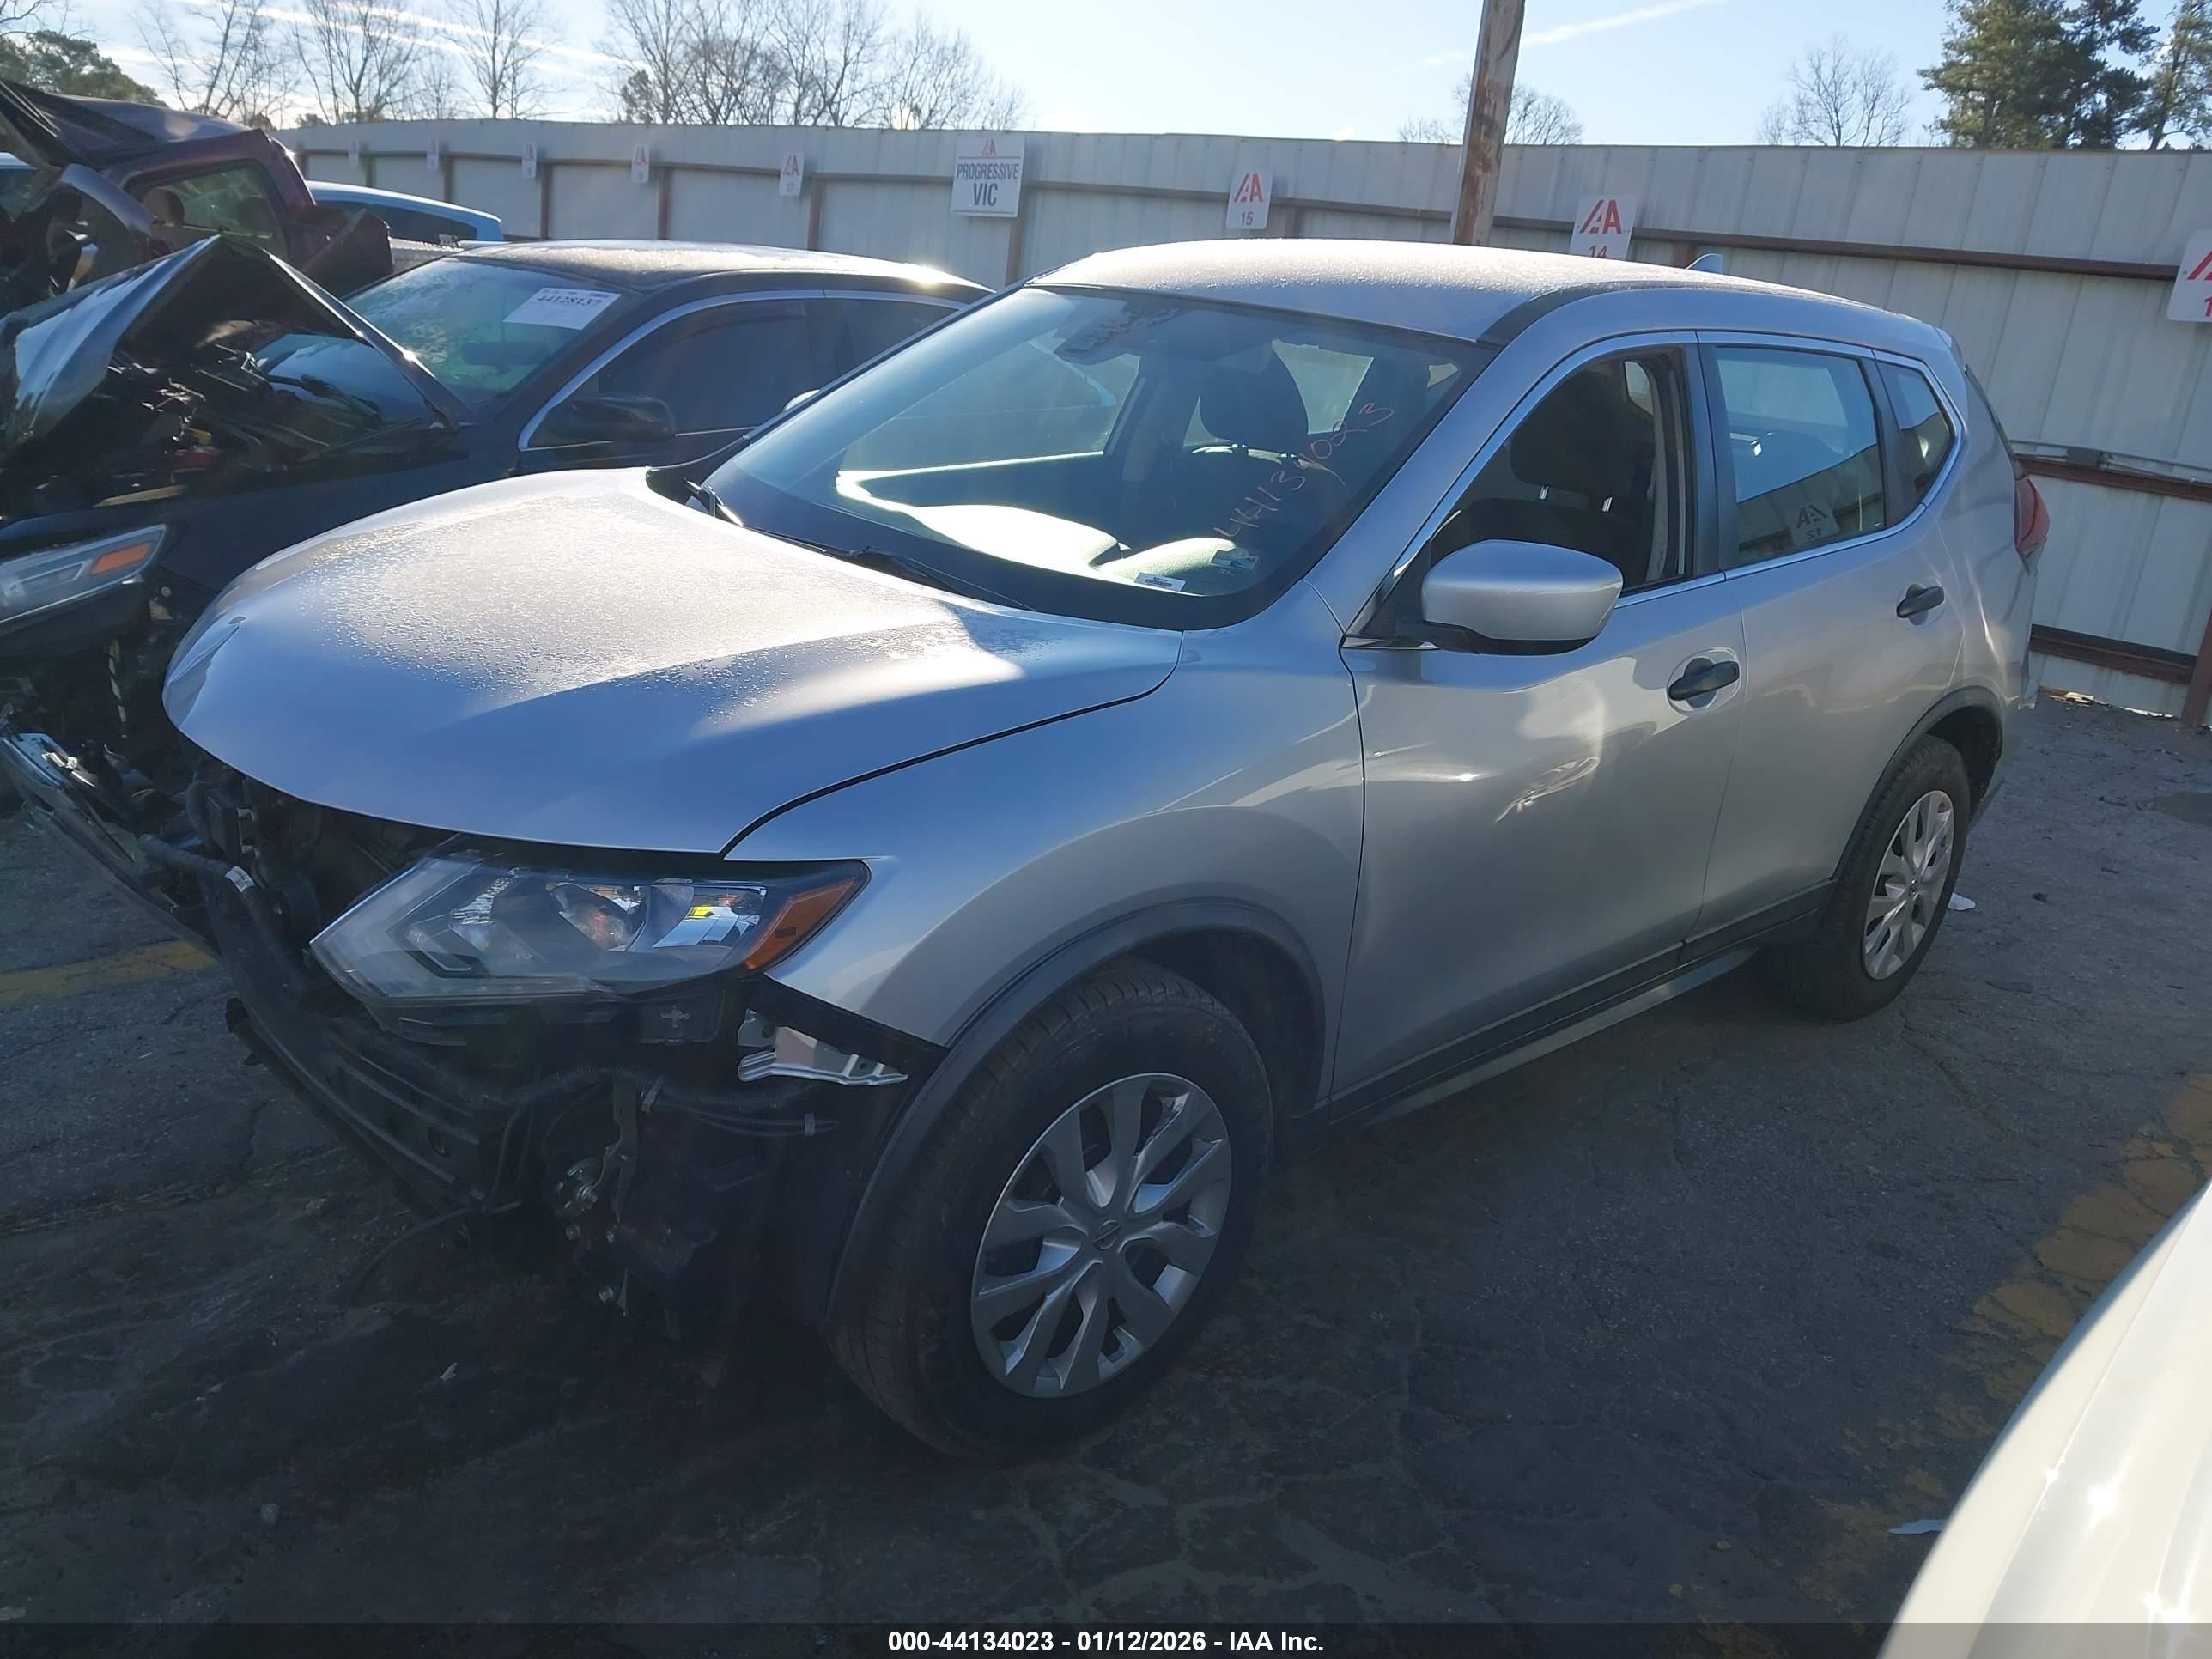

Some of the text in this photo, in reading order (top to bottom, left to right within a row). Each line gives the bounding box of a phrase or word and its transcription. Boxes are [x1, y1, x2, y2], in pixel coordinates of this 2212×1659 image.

[956, 163, 1019, 179] PROGRESSIVE
[972, 183, 999, 206] VIC
[1242, 211, 1254, 226] 15
